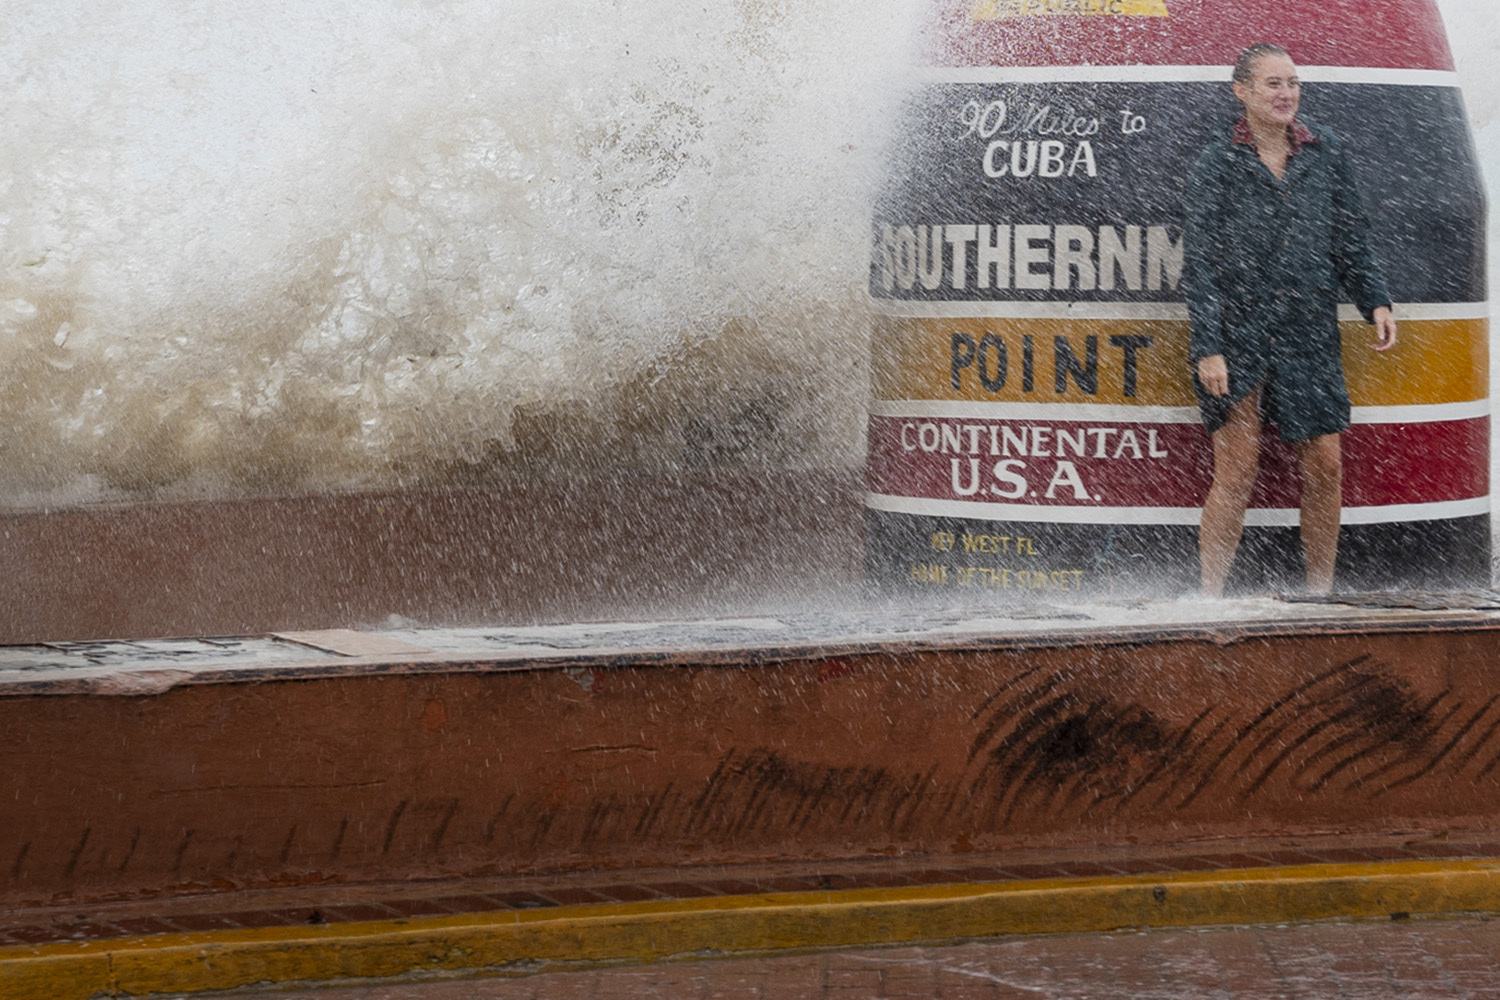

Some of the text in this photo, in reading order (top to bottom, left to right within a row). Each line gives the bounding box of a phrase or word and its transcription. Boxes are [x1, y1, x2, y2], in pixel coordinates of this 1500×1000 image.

[957, 100, 1007, 139] 90
[1119, 107, 1146, 134] to
[982, 140, 1098, 178] CUBA
[881, 224, 1184, 290] SOUTHERNM
[951, 333, 1154, 397] POINT
[901, 423, 1168, 459] CONTINENTAL
[950, 459, 1102, 500] U.S.A.
[962, 533, 1011, 554] WEST
[1016, 537, 1037, 555] FL
[911, 563, 1084, 591] HOME OF THE SUNSET
